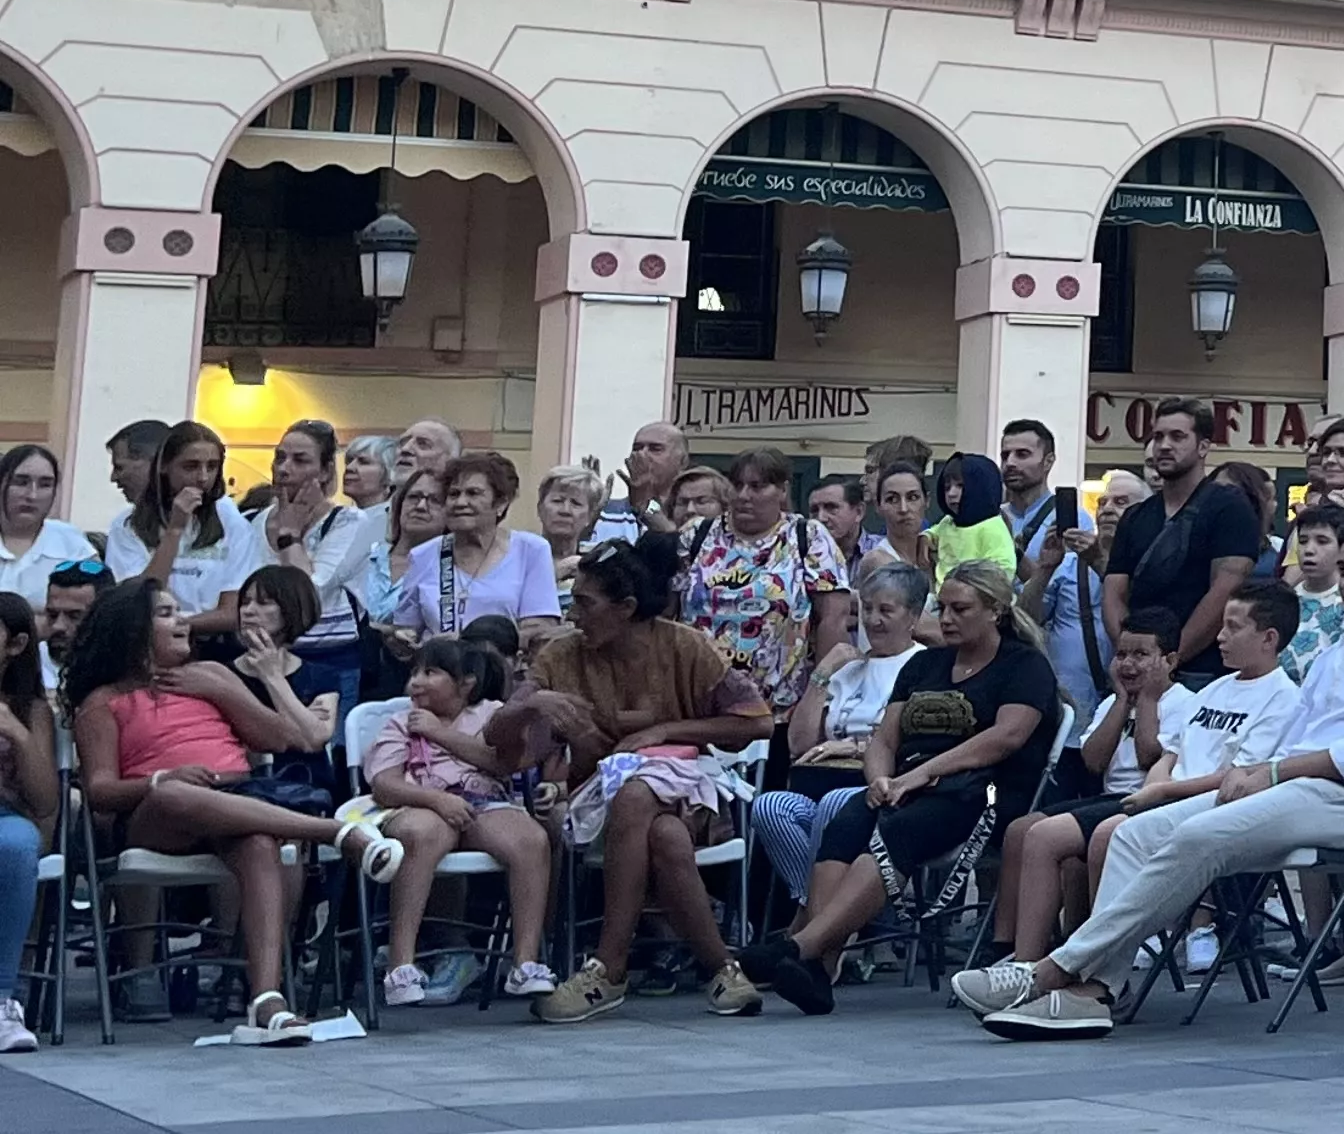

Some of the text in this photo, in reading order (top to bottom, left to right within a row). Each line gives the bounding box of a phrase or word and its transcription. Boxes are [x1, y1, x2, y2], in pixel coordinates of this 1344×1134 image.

[765, 176, 794, 191] sus
[803, 175, 926, 201] especialidades
[1185, 195, 1282, 228] LA CONFIANZA
[1087, 391, 1308, 447] COFIA
